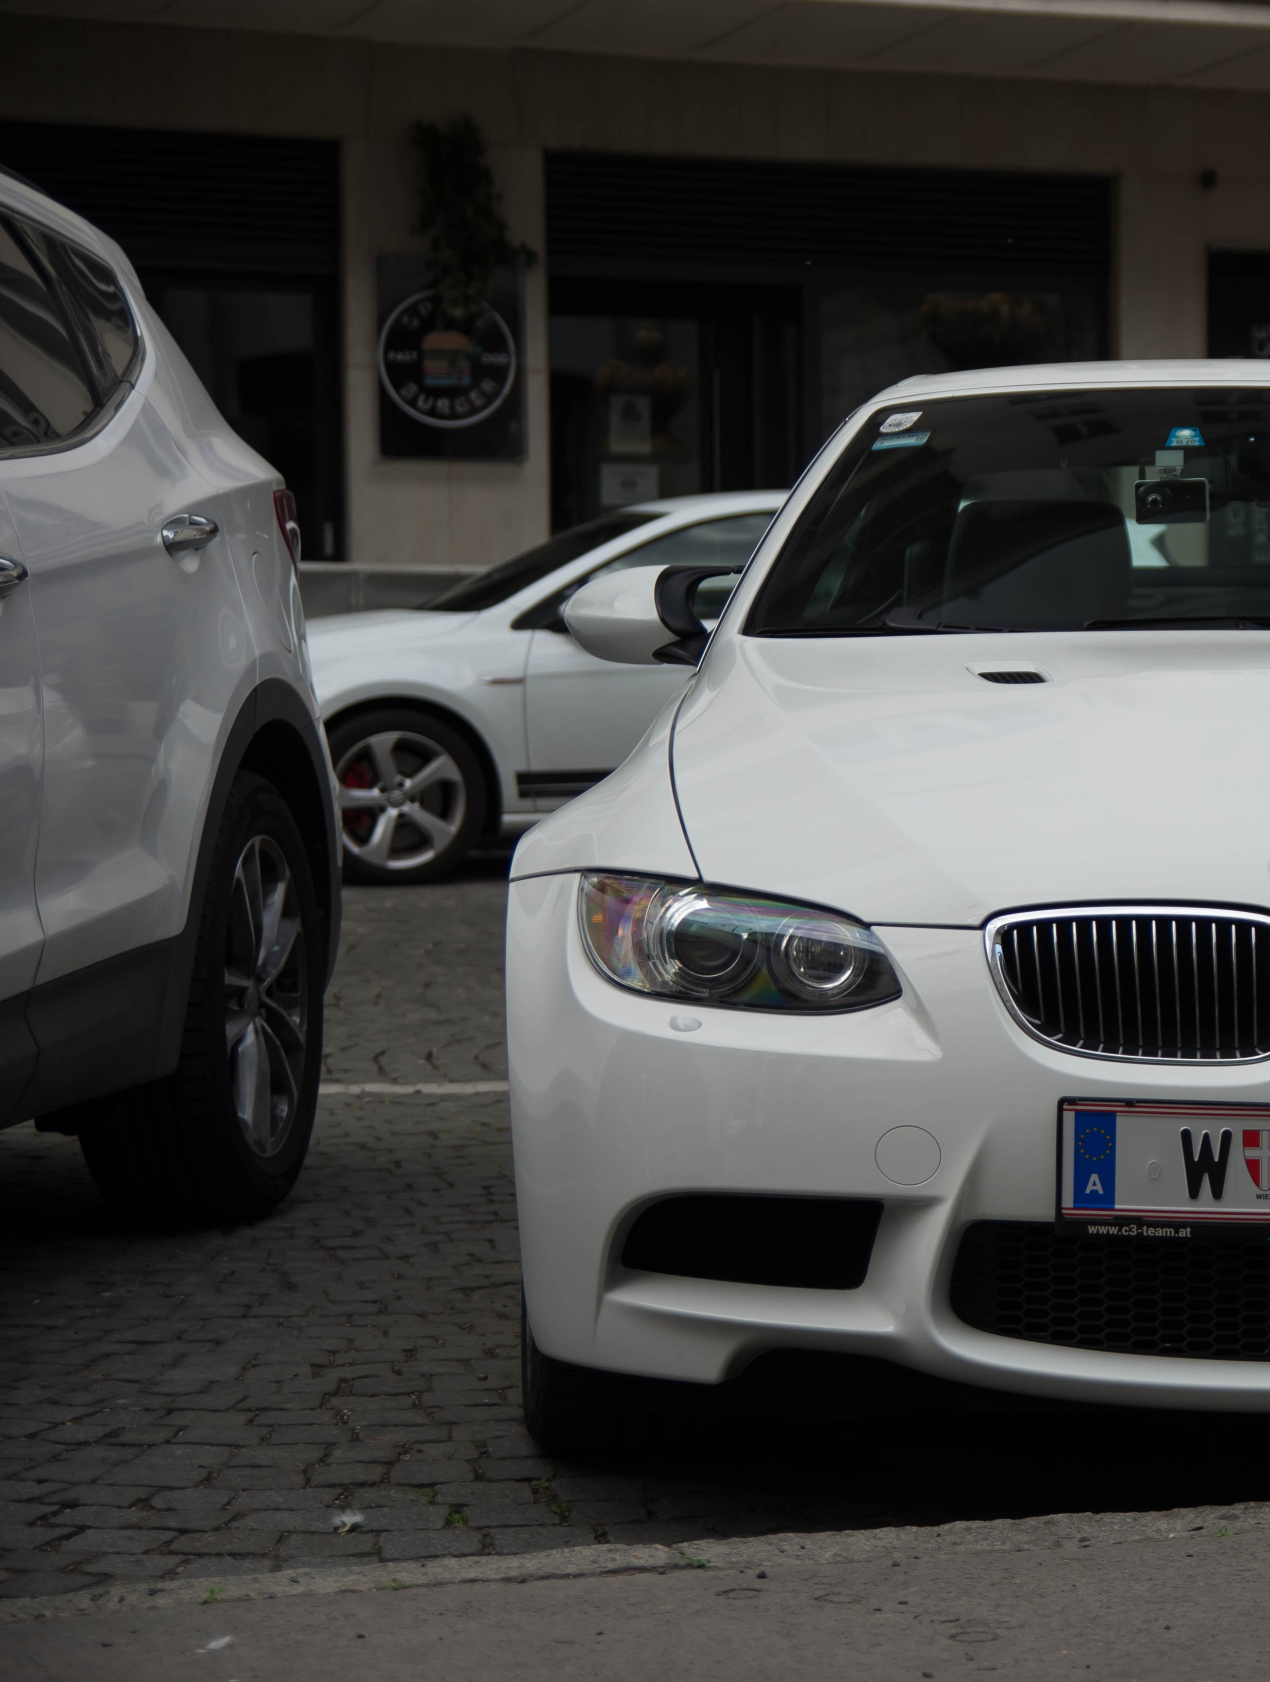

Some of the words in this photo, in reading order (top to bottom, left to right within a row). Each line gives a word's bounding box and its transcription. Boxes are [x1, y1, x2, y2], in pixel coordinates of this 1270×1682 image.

[399, 377, 500, 417] BURGER
[1180, 1126, 1232, 1201] W
[1085, 1173, 1104, 1195] A
[1087, 1224, 1192, 1238] www.c3-team.at
